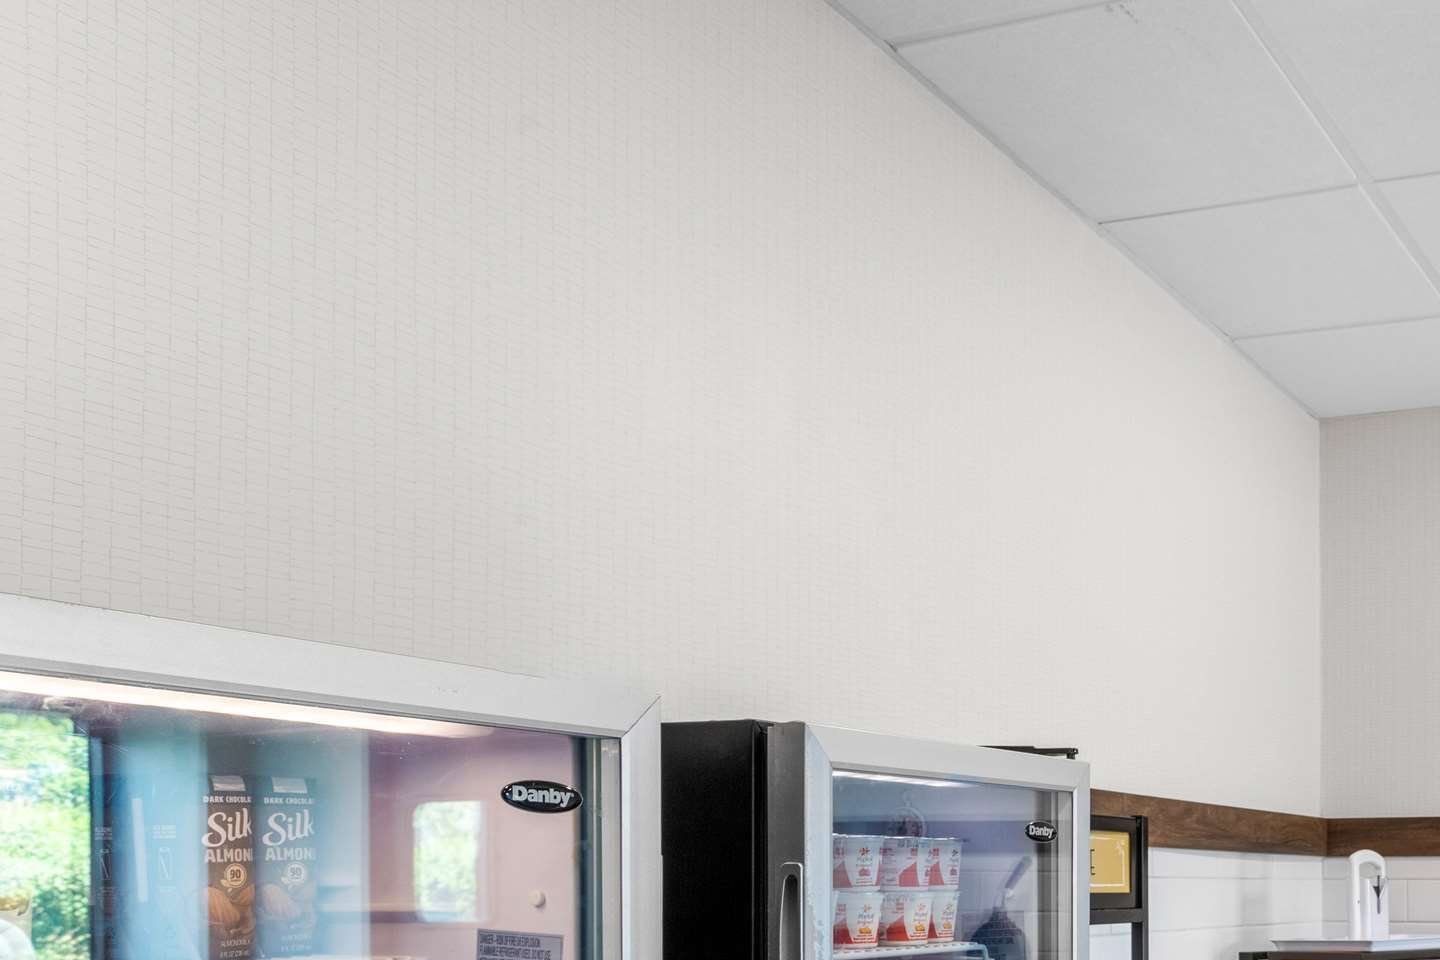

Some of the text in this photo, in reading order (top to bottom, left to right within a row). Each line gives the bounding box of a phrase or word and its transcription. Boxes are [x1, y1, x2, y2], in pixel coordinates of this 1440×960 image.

[512, 785, 572, 808] Danby
[201, 808, 252, 847] Silk
[262, 809, 315, 846] Silk
[1028, 825, 1054, 839] Danby
[204, 848, 253, 863] ALMON
[265, 848, 315, 861] ALMON
[230, 869, 241, 879] 90
